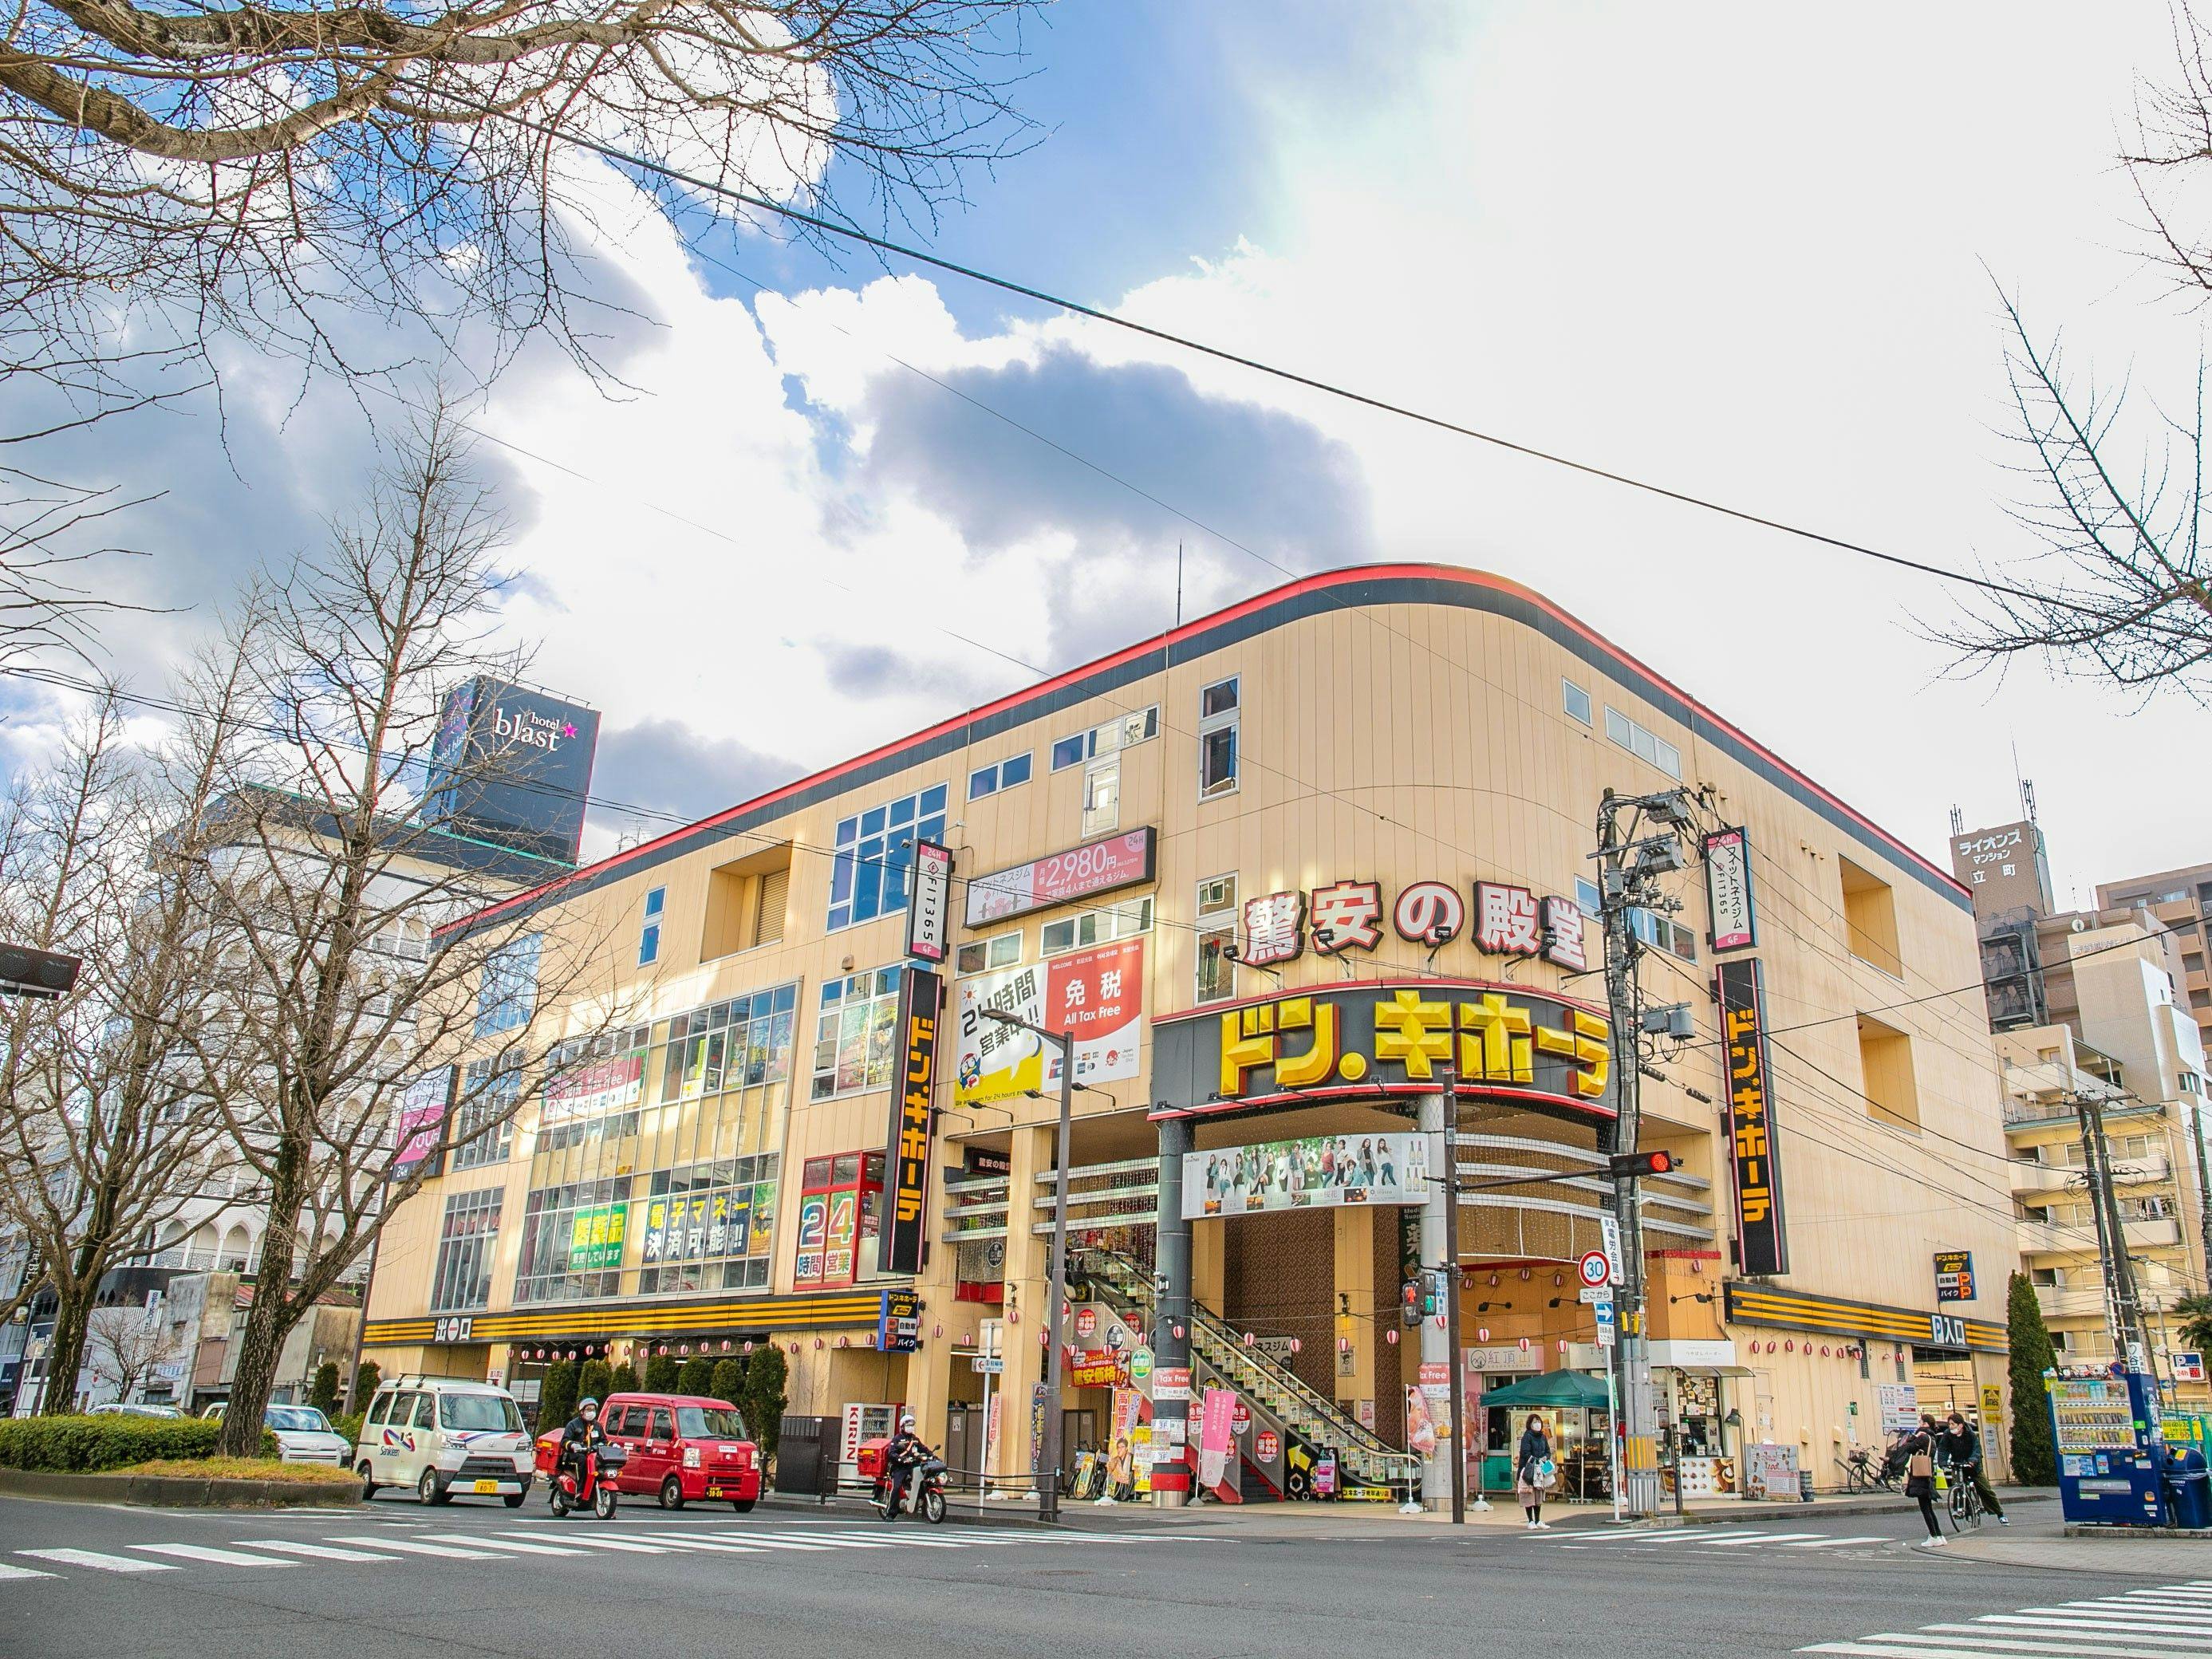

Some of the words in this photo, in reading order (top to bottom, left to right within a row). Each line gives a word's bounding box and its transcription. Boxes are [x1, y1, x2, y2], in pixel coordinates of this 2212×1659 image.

[495, 708, 560, 751] blast
[531, 712, 559, 729] hotel
[1128, 835, 1143, 846] 24H
[1958, 829, 2022, 856] ライオンズ
[927, 848, 941, 860] 24H
[1973, 849, 2011, 865] マンション
[1046, 845, 1117, 888] 2,980円
[1717, 873, 1728, 915] FIT365
[1728, 846, 1743, 929] フィットネスジム
[924, 877, 937, 941] FIT365
[1244, 881, 1586, 971] 驚安の殿堂
[922, 945, 933, 954] 4F
[1727, 936, 1739, 944] 4F
[1052, 961, 1073, 970] WELCOME
[1065, 969, 1122, 1008] 免税
[962, 968, 1037, 1038] 24時間
[1063, 1013, 1077, 1026] All
[1078, 1011, 1096, 1023] Tax
[1098, 1004, 1122, 1019] Free
[1001, 1090, 1015, 1099] hours
[651, 1197, 750, 1229] 電子マネー
[574, 1213, 625, 1247] 医薬品
[800, 1198, 854, 1248] 24
[1604, 1219, 1615, 1228] 東北
[573, 1248, 621, 1264] 販売しています
[1587, 1261, 1603, 1277] 30
[1583, 1291, 1610, 1300] ここから
[435, 1317, 472, 1342] 出口
[2176, 1356, 2186, 1367] P
[1174, 1374, 1189, 1383] Free
[1429, 1371, 1447, 1380] Free
[846, 1406, 859, 1460] KIRIN
